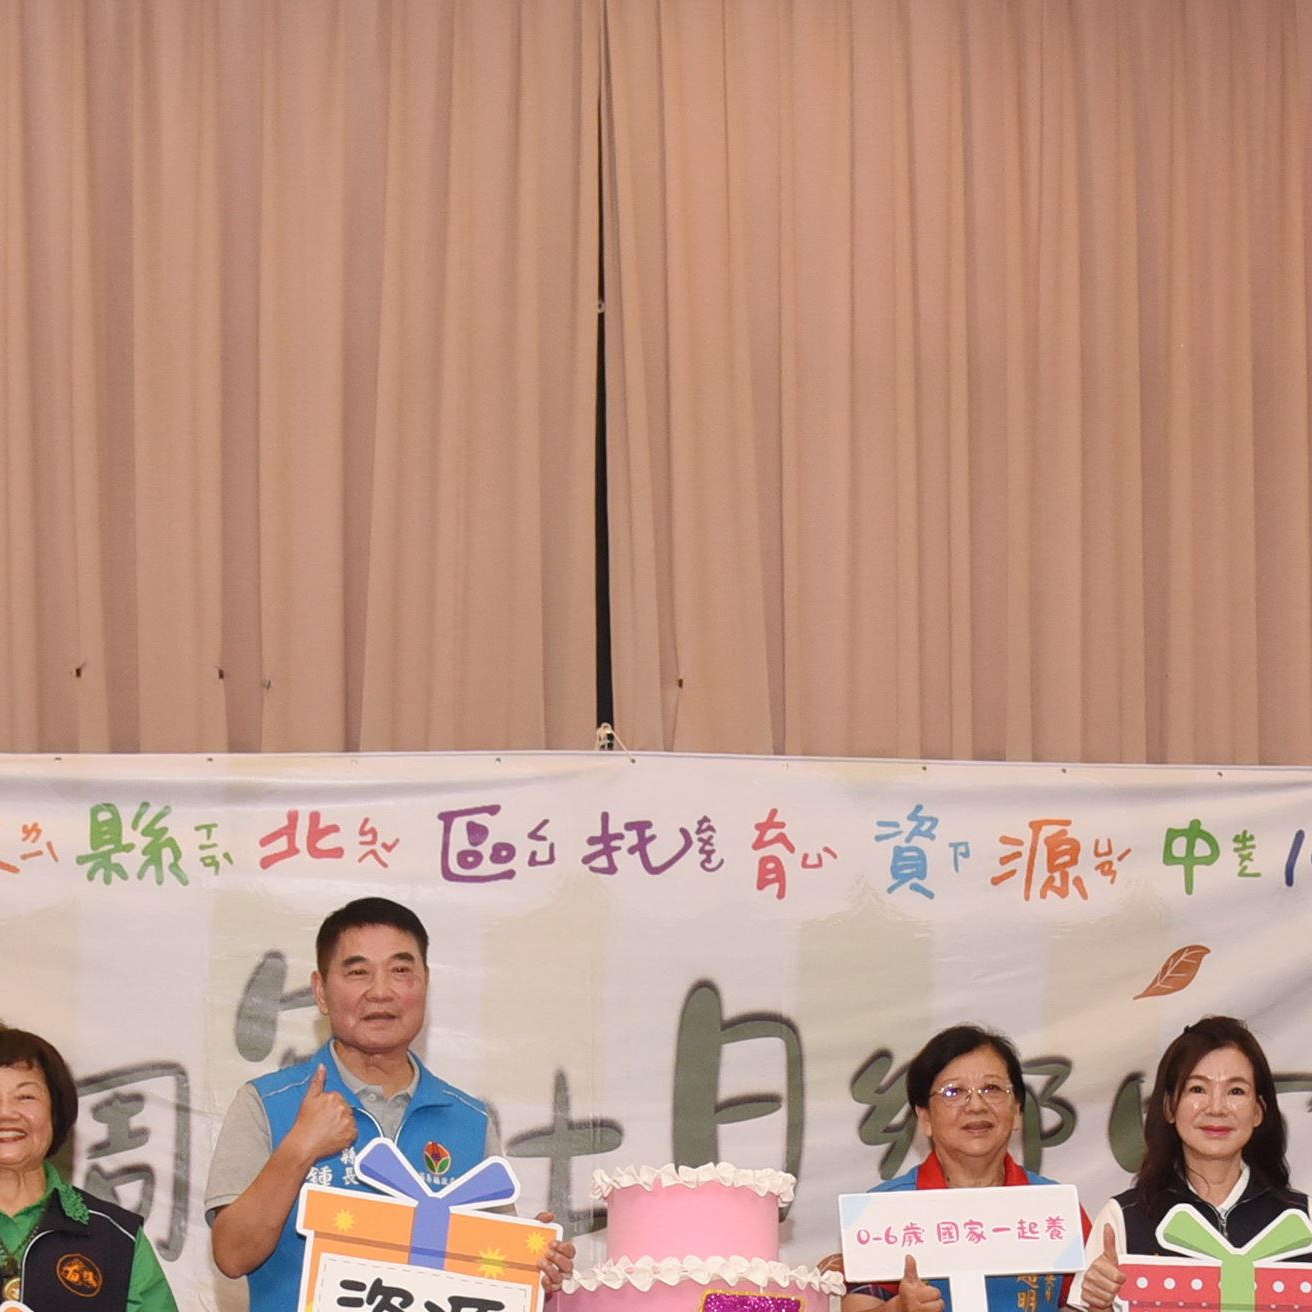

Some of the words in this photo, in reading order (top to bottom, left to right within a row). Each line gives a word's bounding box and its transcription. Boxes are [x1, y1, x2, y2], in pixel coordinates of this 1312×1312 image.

[856, 1222, 926, 1248] 0-6歲
[936, 1216, 1066, 1244] 國家一起養
